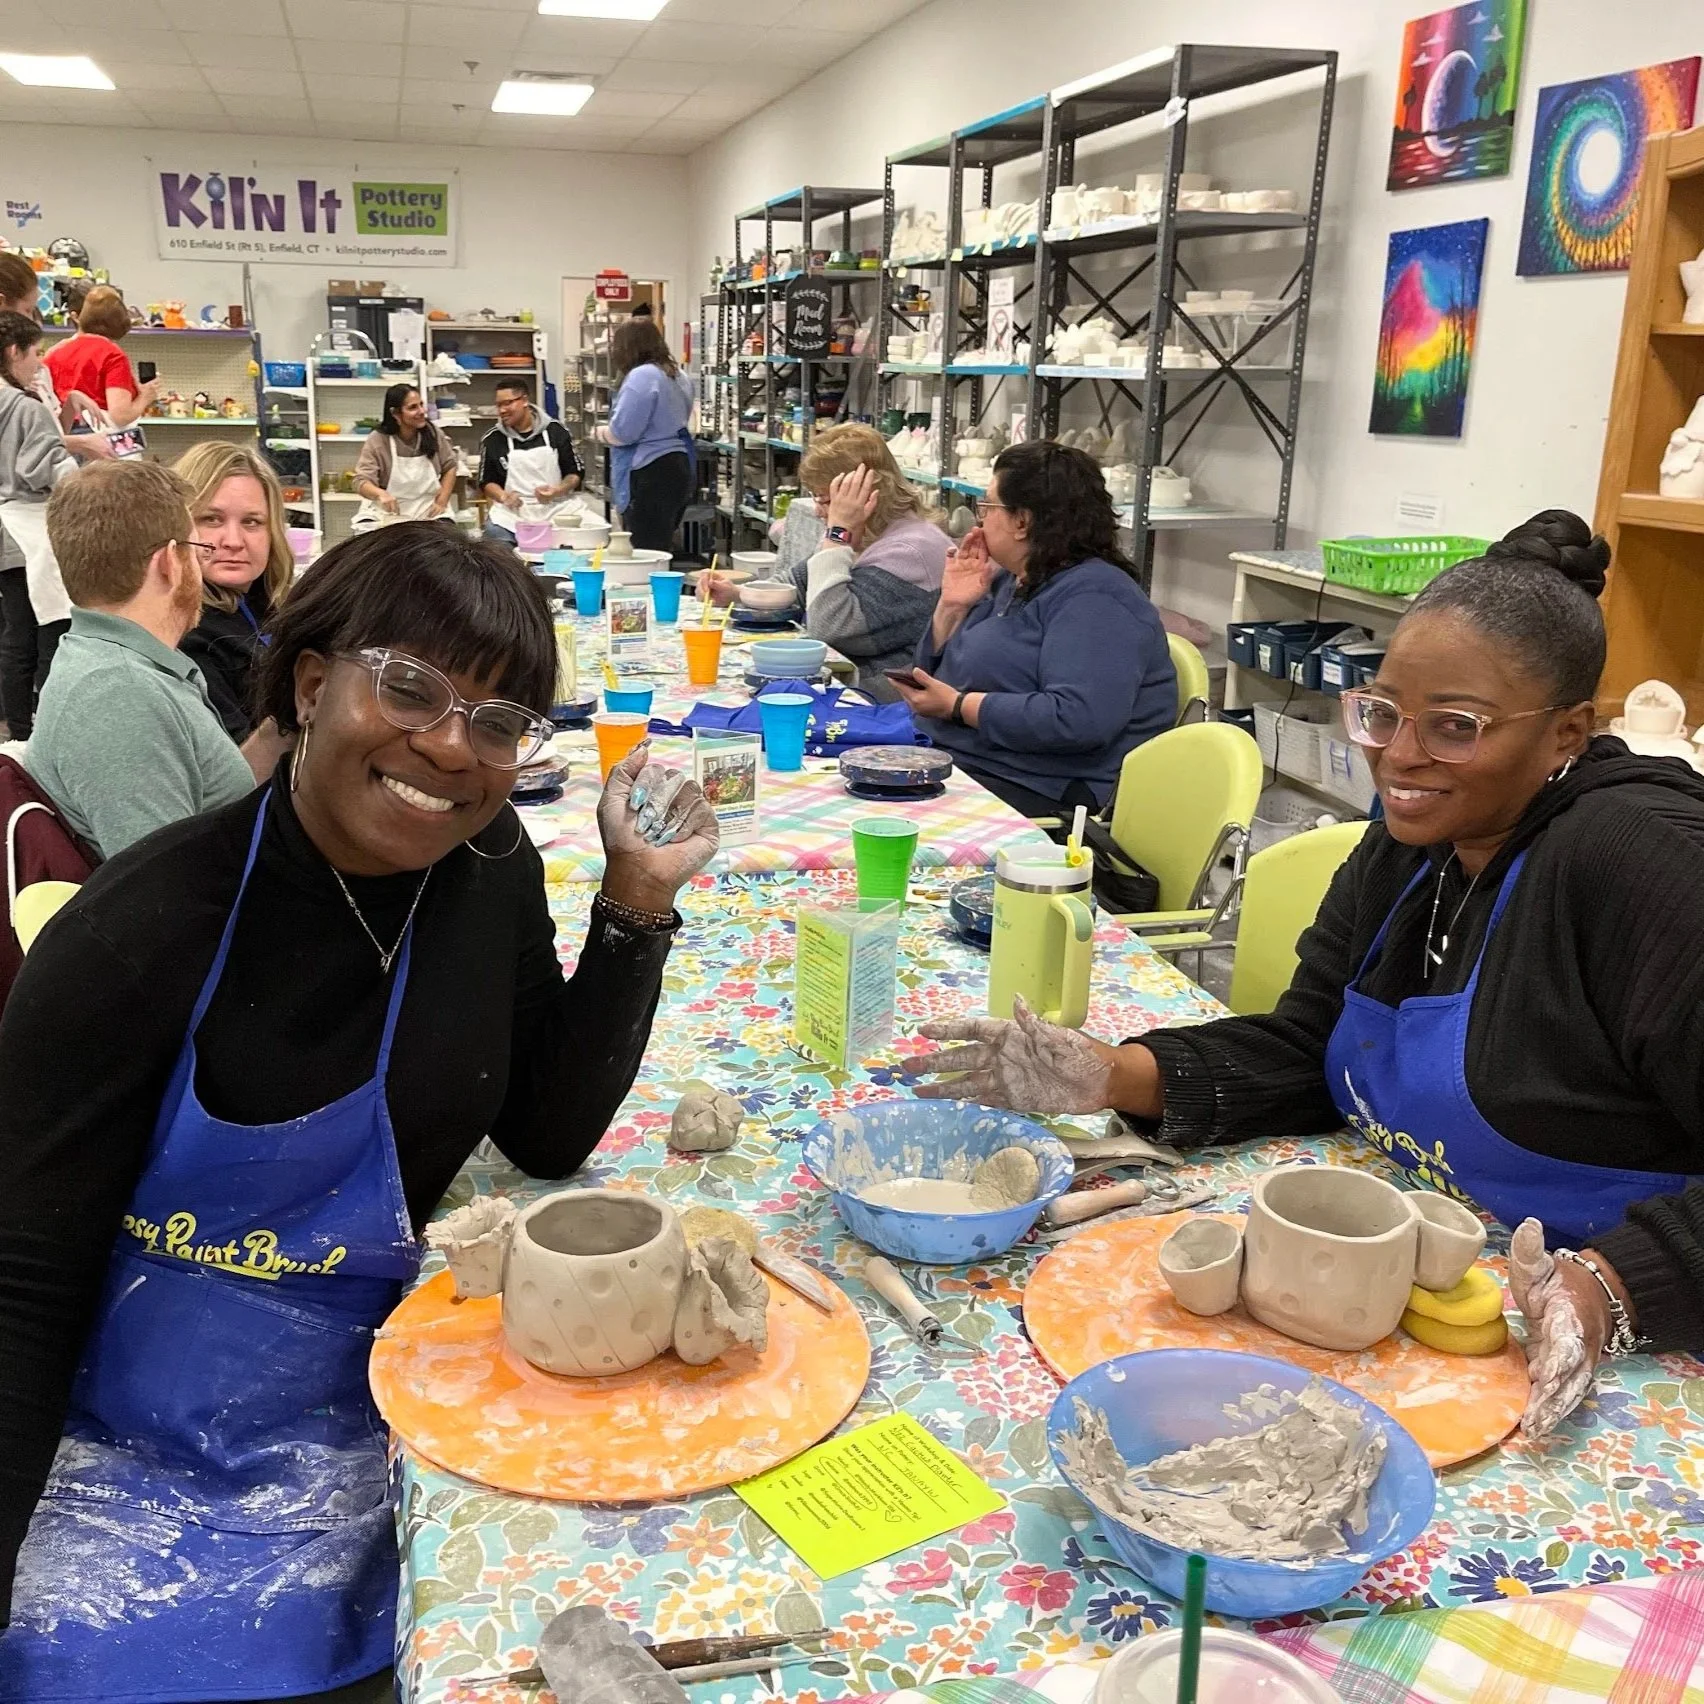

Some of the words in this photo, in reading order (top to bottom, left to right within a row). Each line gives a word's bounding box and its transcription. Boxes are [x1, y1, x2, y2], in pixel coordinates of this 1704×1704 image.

[6, 200, 29, 210] Rest
[298, 180, 342, 234] It
[360, 188, 443, 210] Pottery
[367, 209, 436, 228] Studio
[169, 240, 187, 249] 610
[190, 240, 223, 250] Enfield
[226, 241, 236, 251] St
[269, 243, 304, 254] Enfield,
[306, 245, 320, 253] CT
[336, 245, 448, 258] kilnitpotterystudio.com
[793, 303, 825, 321] Mud
[793, 320, 825, 337] Room
[165, 1211, 240, 1263] Paint
